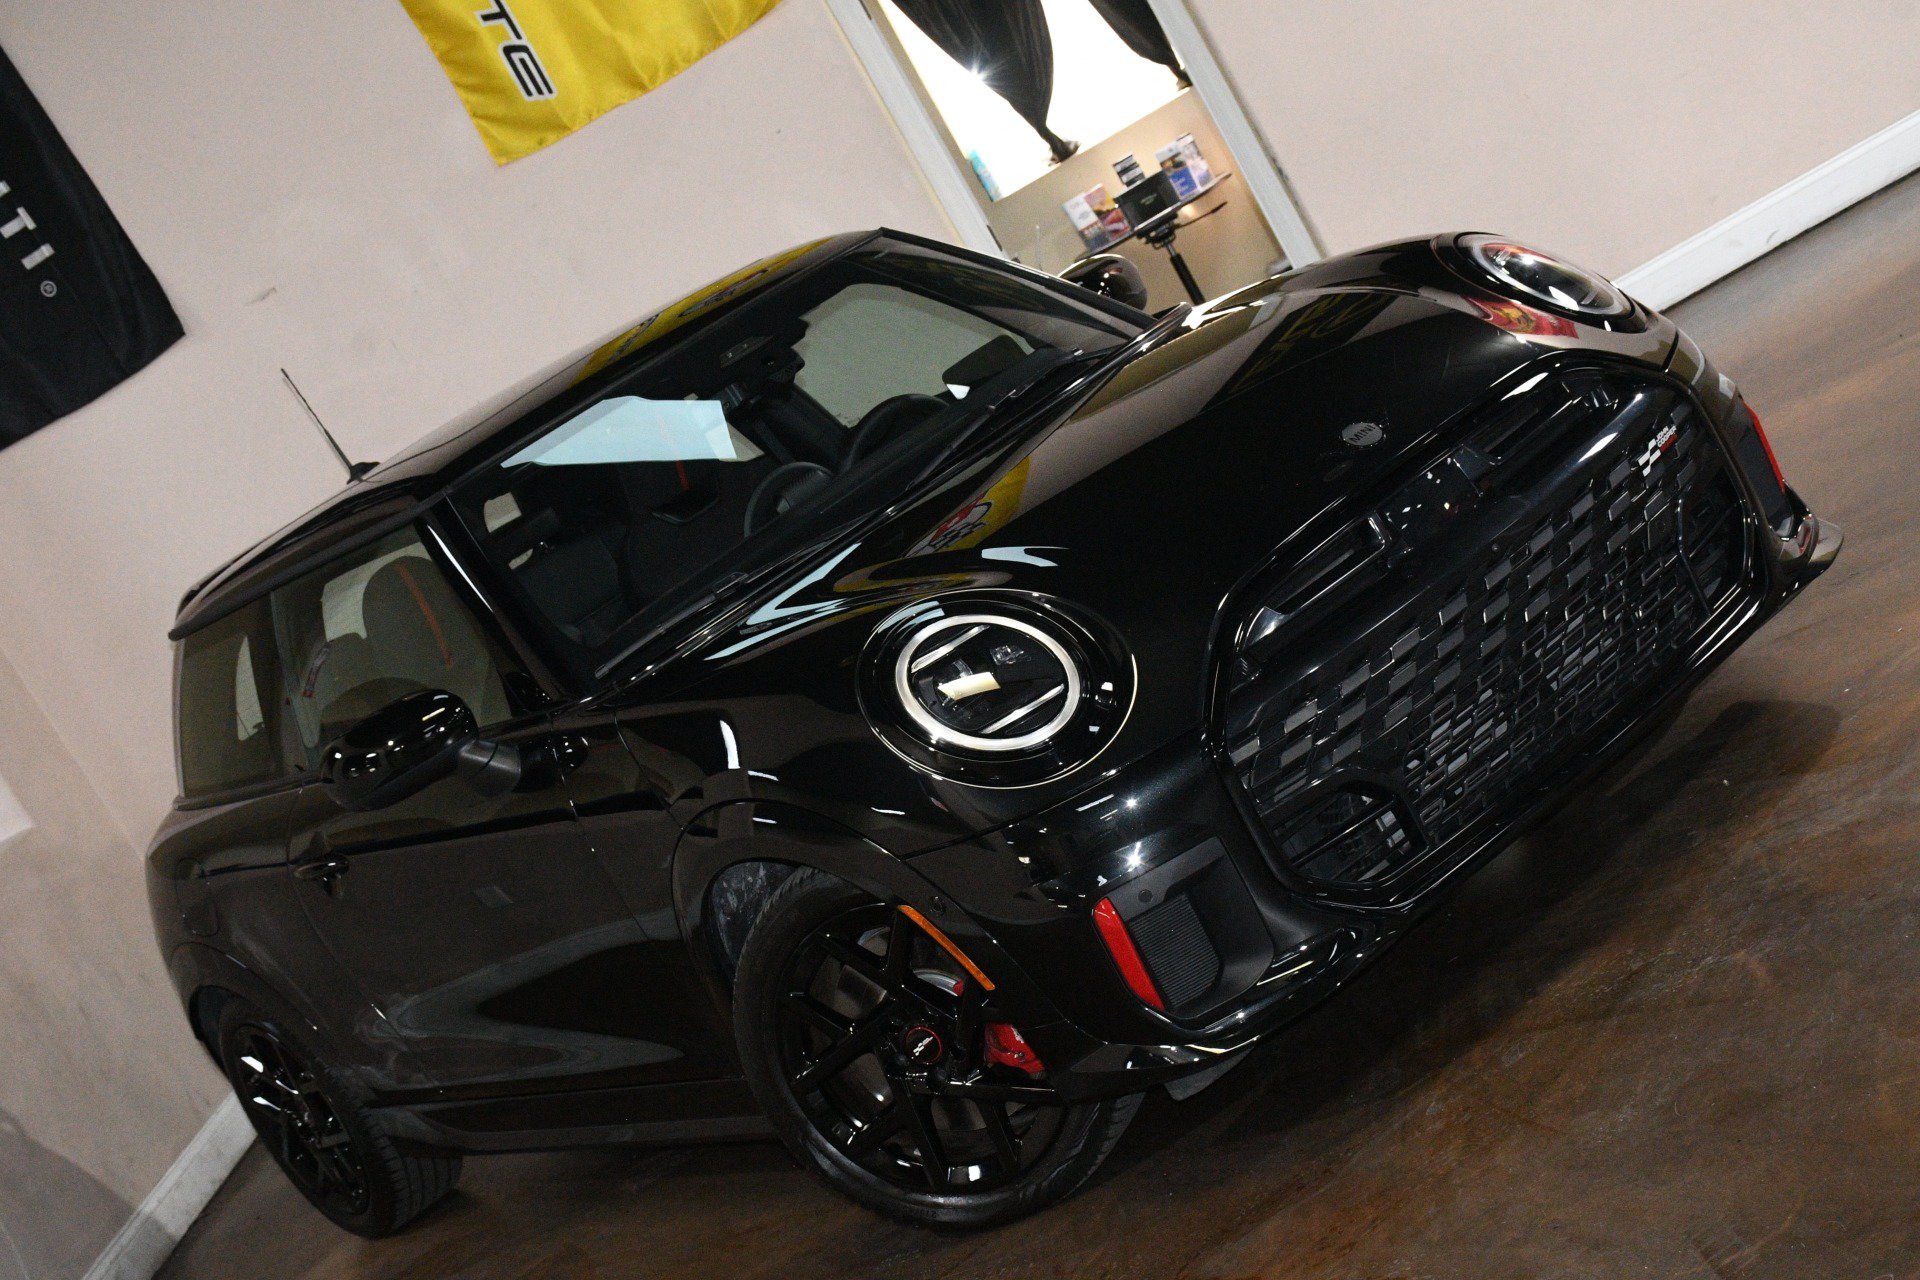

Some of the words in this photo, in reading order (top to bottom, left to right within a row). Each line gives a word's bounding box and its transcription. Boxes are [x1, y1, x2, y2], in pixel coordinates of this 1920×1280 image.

[477, 0, 555, 99] TE
[1349, 424, 1376, 442] MINI
[1656, 425, 1669, 442] JOHN
[1657, 425, 1677, 447] COOPER
